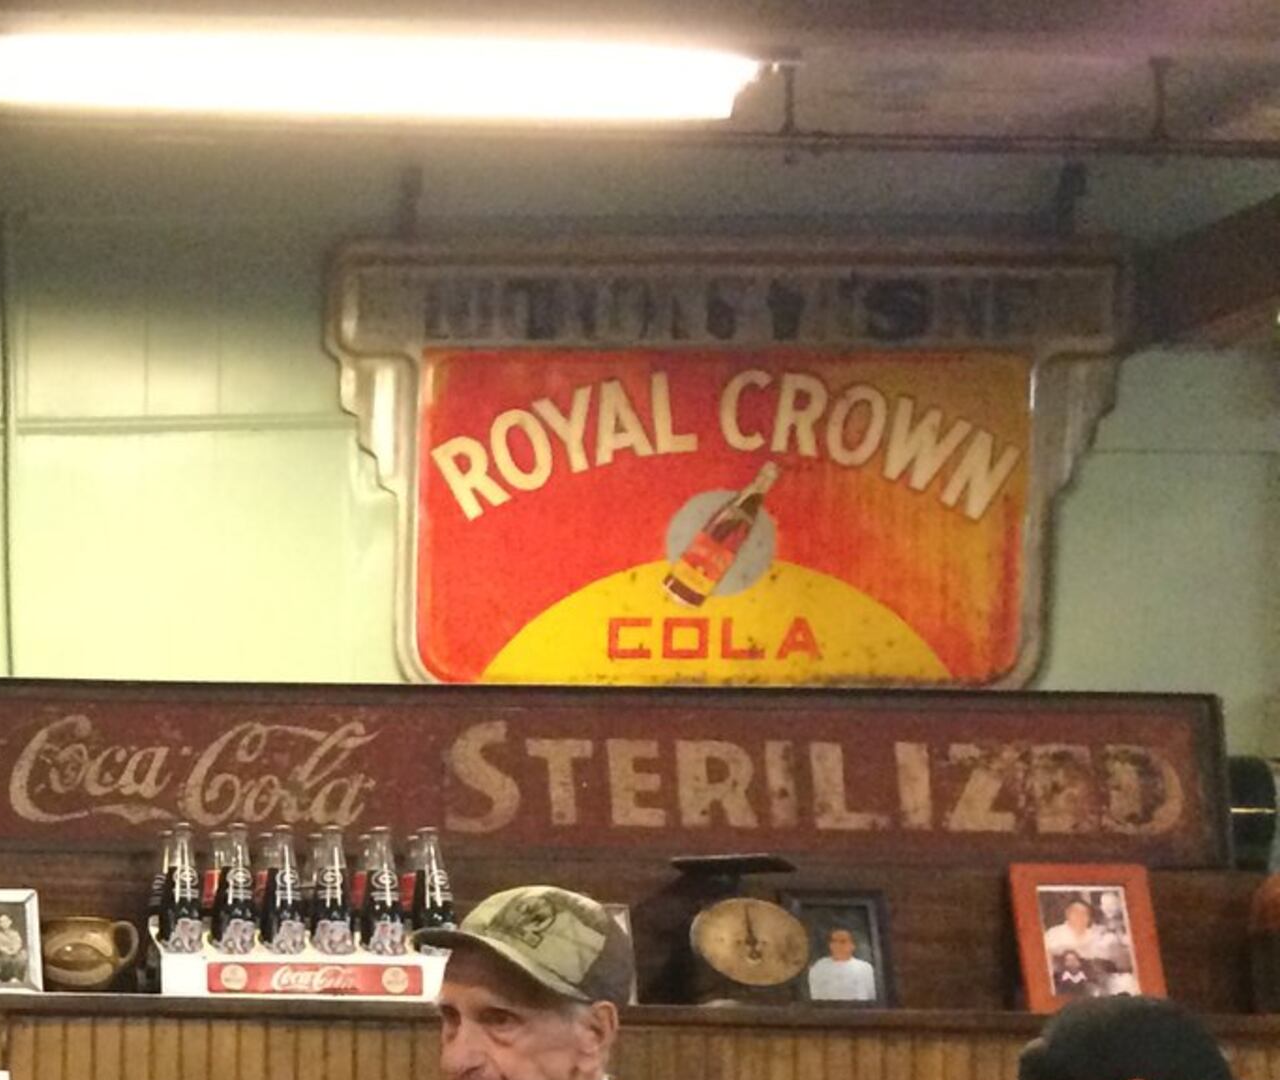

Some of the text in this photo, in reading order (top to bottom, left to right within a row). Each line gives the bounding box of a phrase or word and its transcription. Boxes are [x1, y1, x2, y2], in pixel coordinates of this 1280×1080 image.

[430, 369, 1021, 523] ROYAL CROWN
[607, 616, 823, 660] COLA
[442, 719, 1183, 834] STERILIZED
